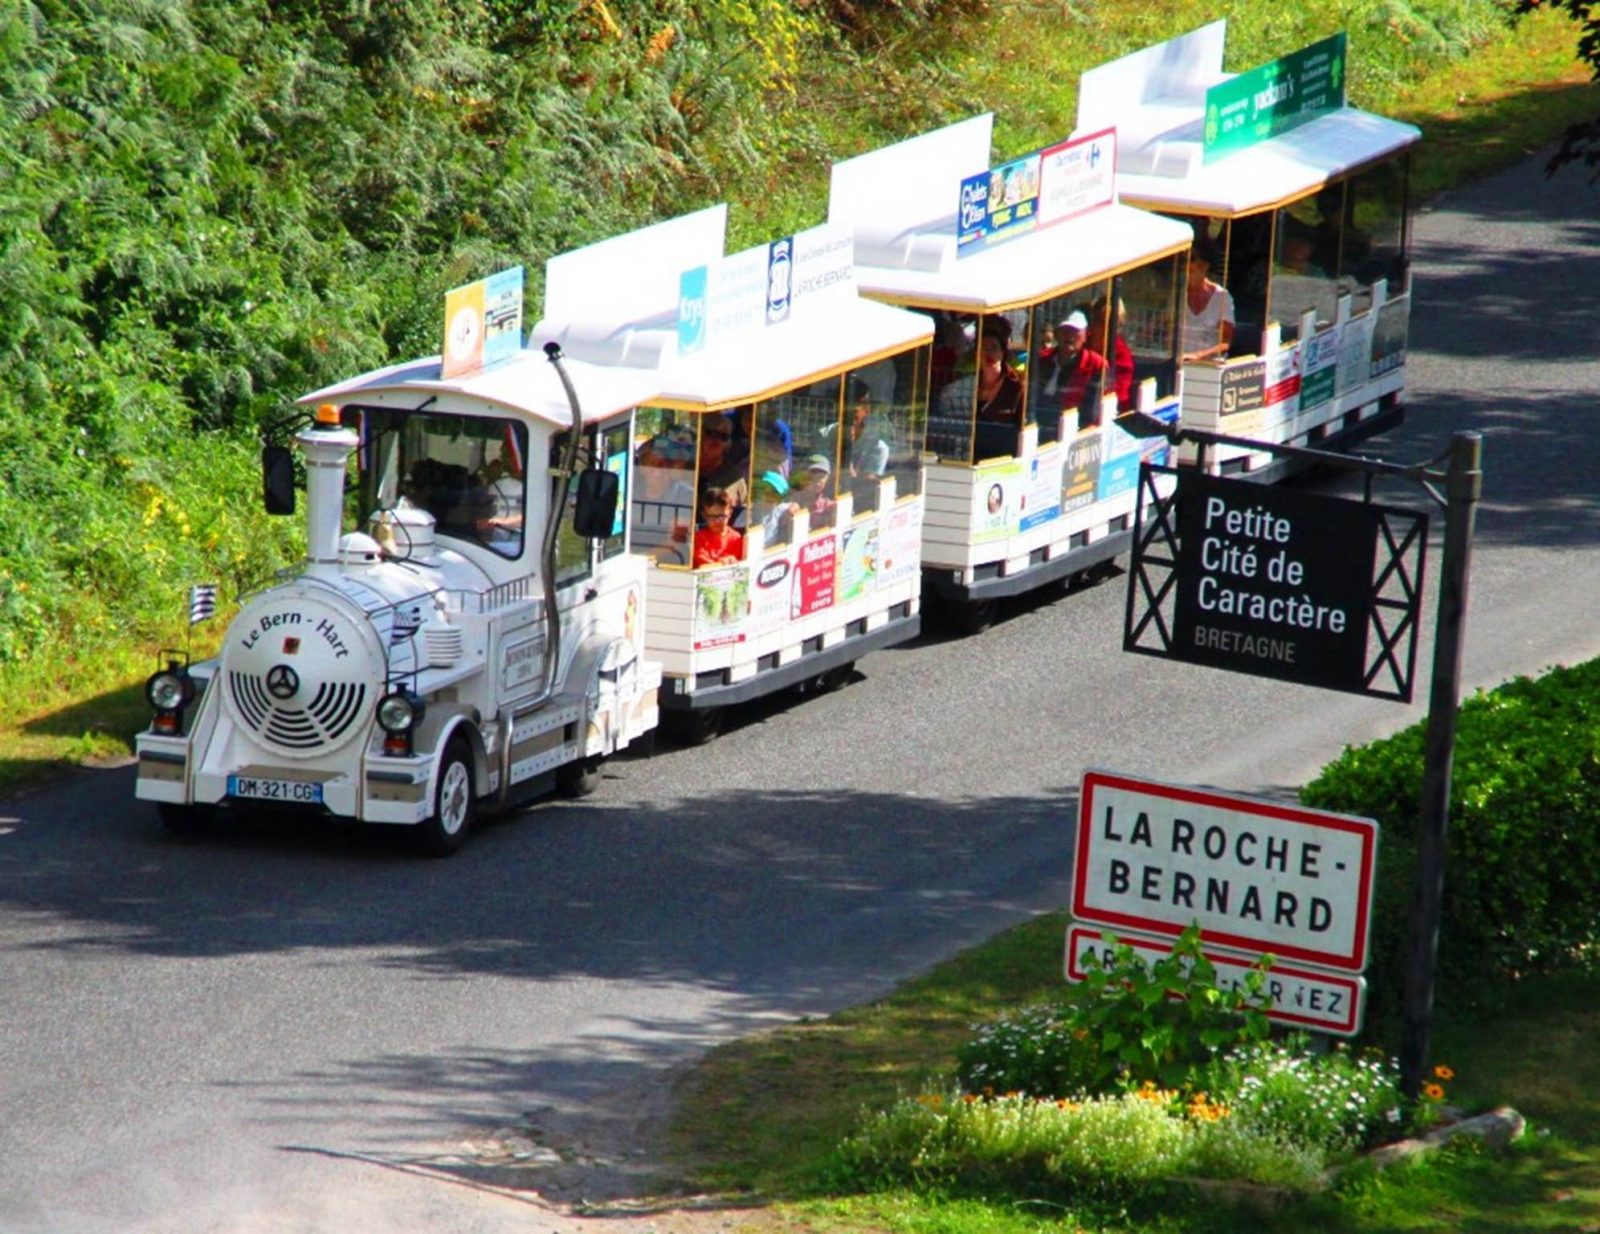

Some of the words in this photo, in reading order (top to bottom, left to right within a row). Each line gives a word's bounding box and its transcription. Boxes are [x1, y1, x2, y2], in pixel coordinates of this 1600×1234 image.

[1205, 497, 1290, 542] Petite
[1201, 536, 1257, 577] Cité
[1267, 550, 1304, 586] de
[1197, 576, 1347, 634] Caractère
[241, 629, 260, 650] Le
[260, 612, 302, 632] Bern
[316, 618, 349, 659] Hart
[1194, 625, 1296, 663] BRETAGNE
[1104, 806, 1153, 848] LA
[1109, 859, 1332, 932] BERNARD
